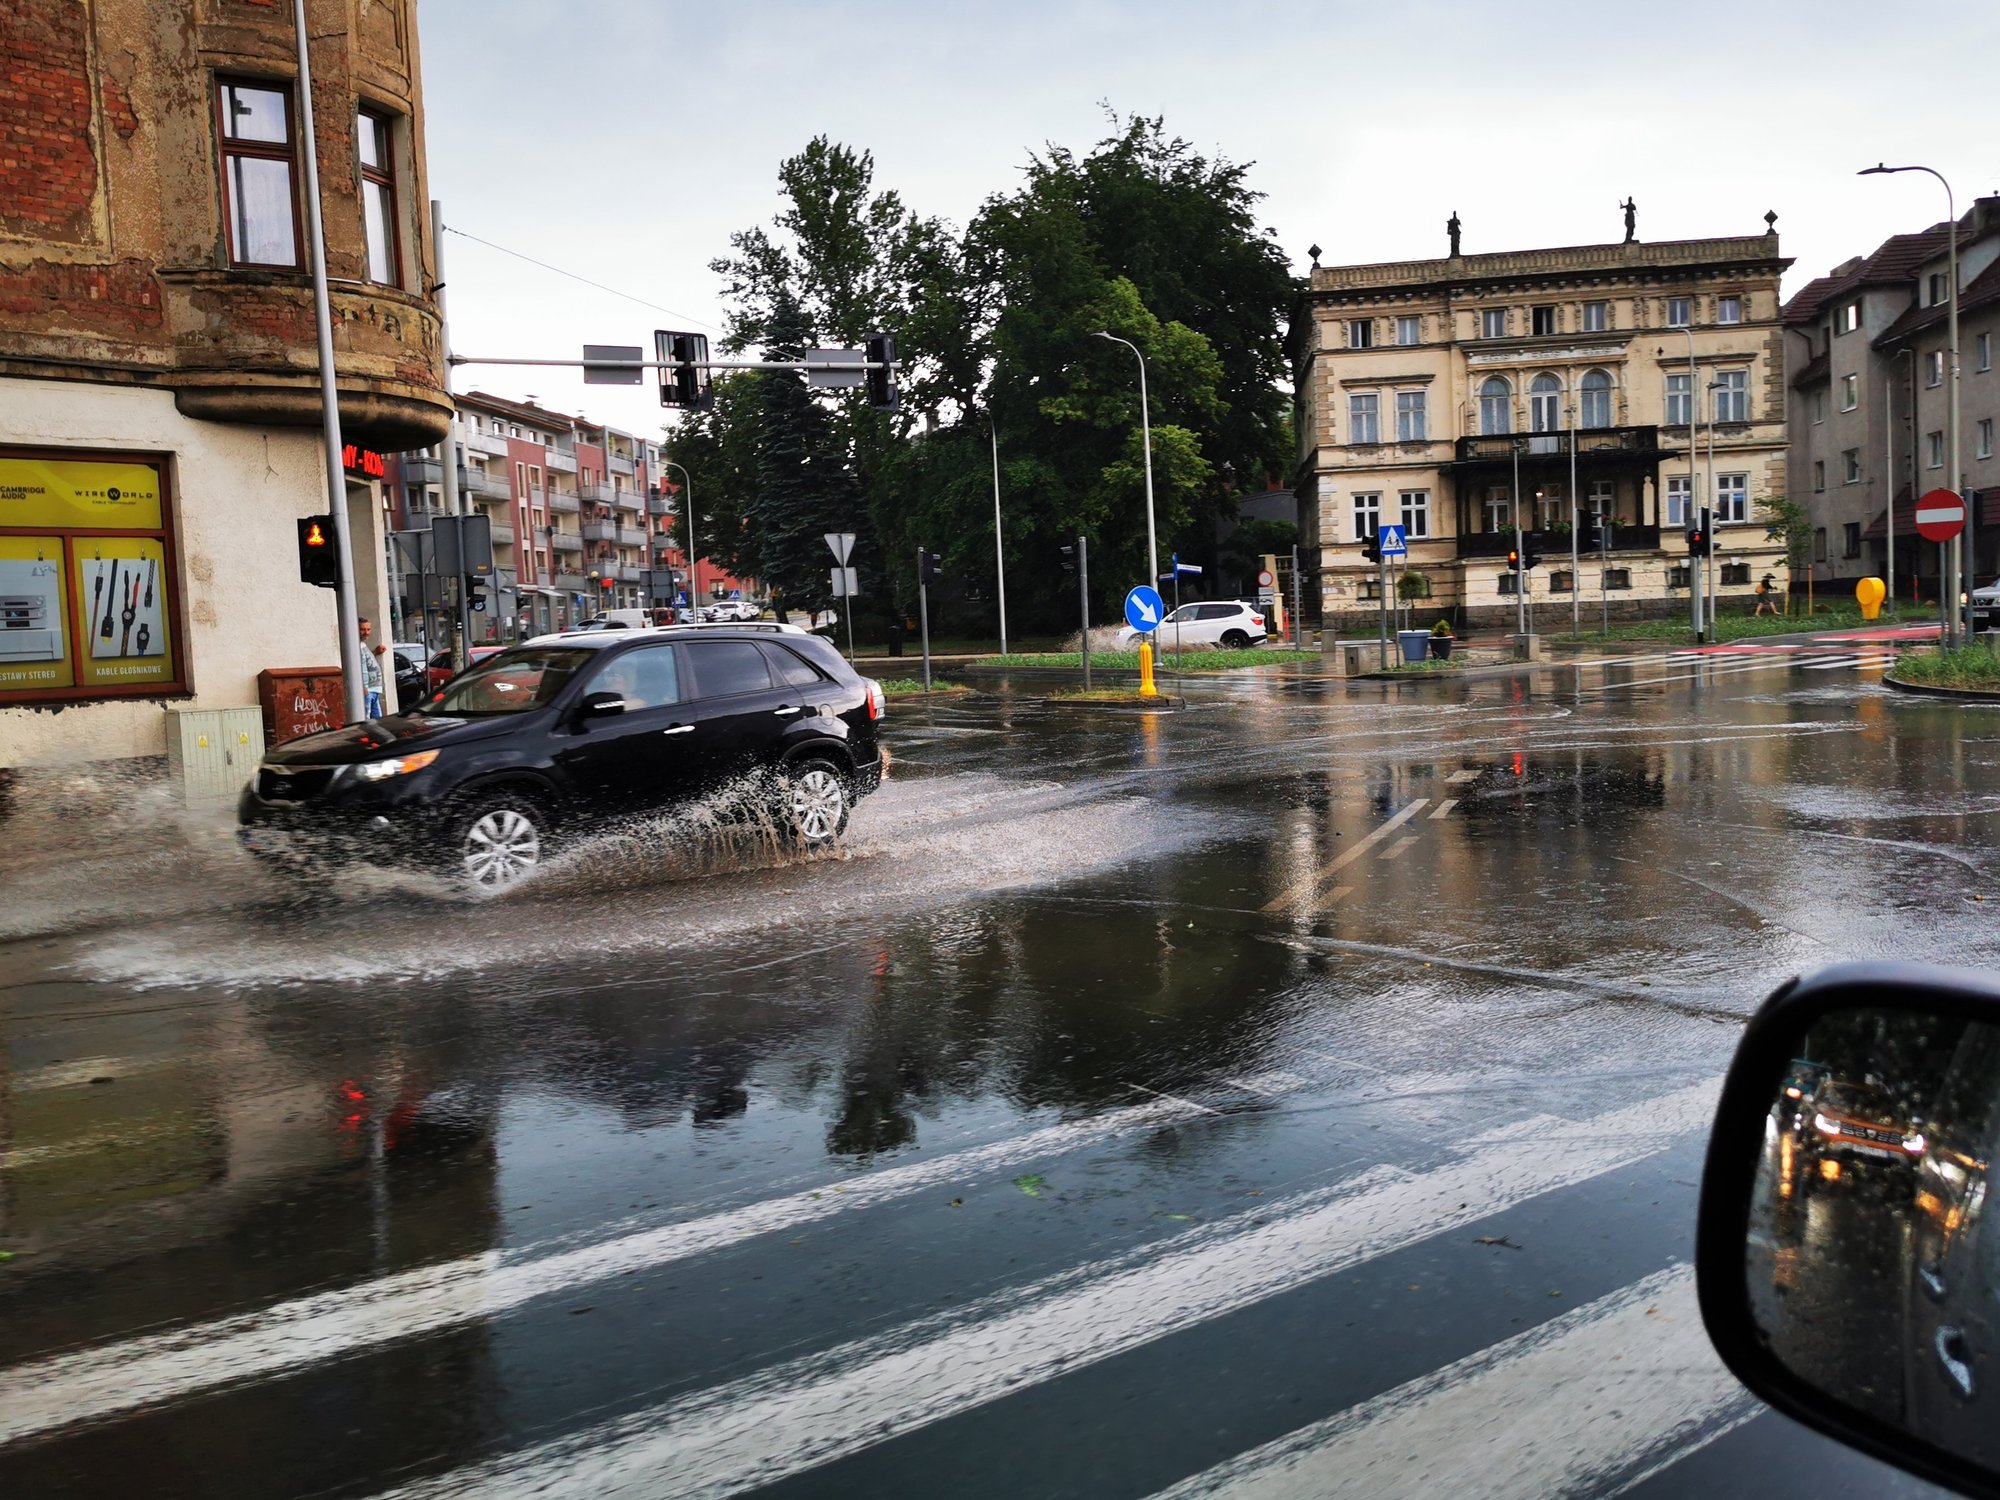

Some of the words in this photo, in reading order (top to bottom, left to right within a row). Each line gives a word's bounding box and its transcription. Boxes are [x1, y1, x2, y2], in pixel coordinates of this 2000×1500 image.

[0, 486, 46, 494] CAMBRIDGE
[28, 670, 56, 680] STEREO
[96, 667, 118, 676] KABLE
[120, 665, 162, 675] GŁOŚNIKOWE
